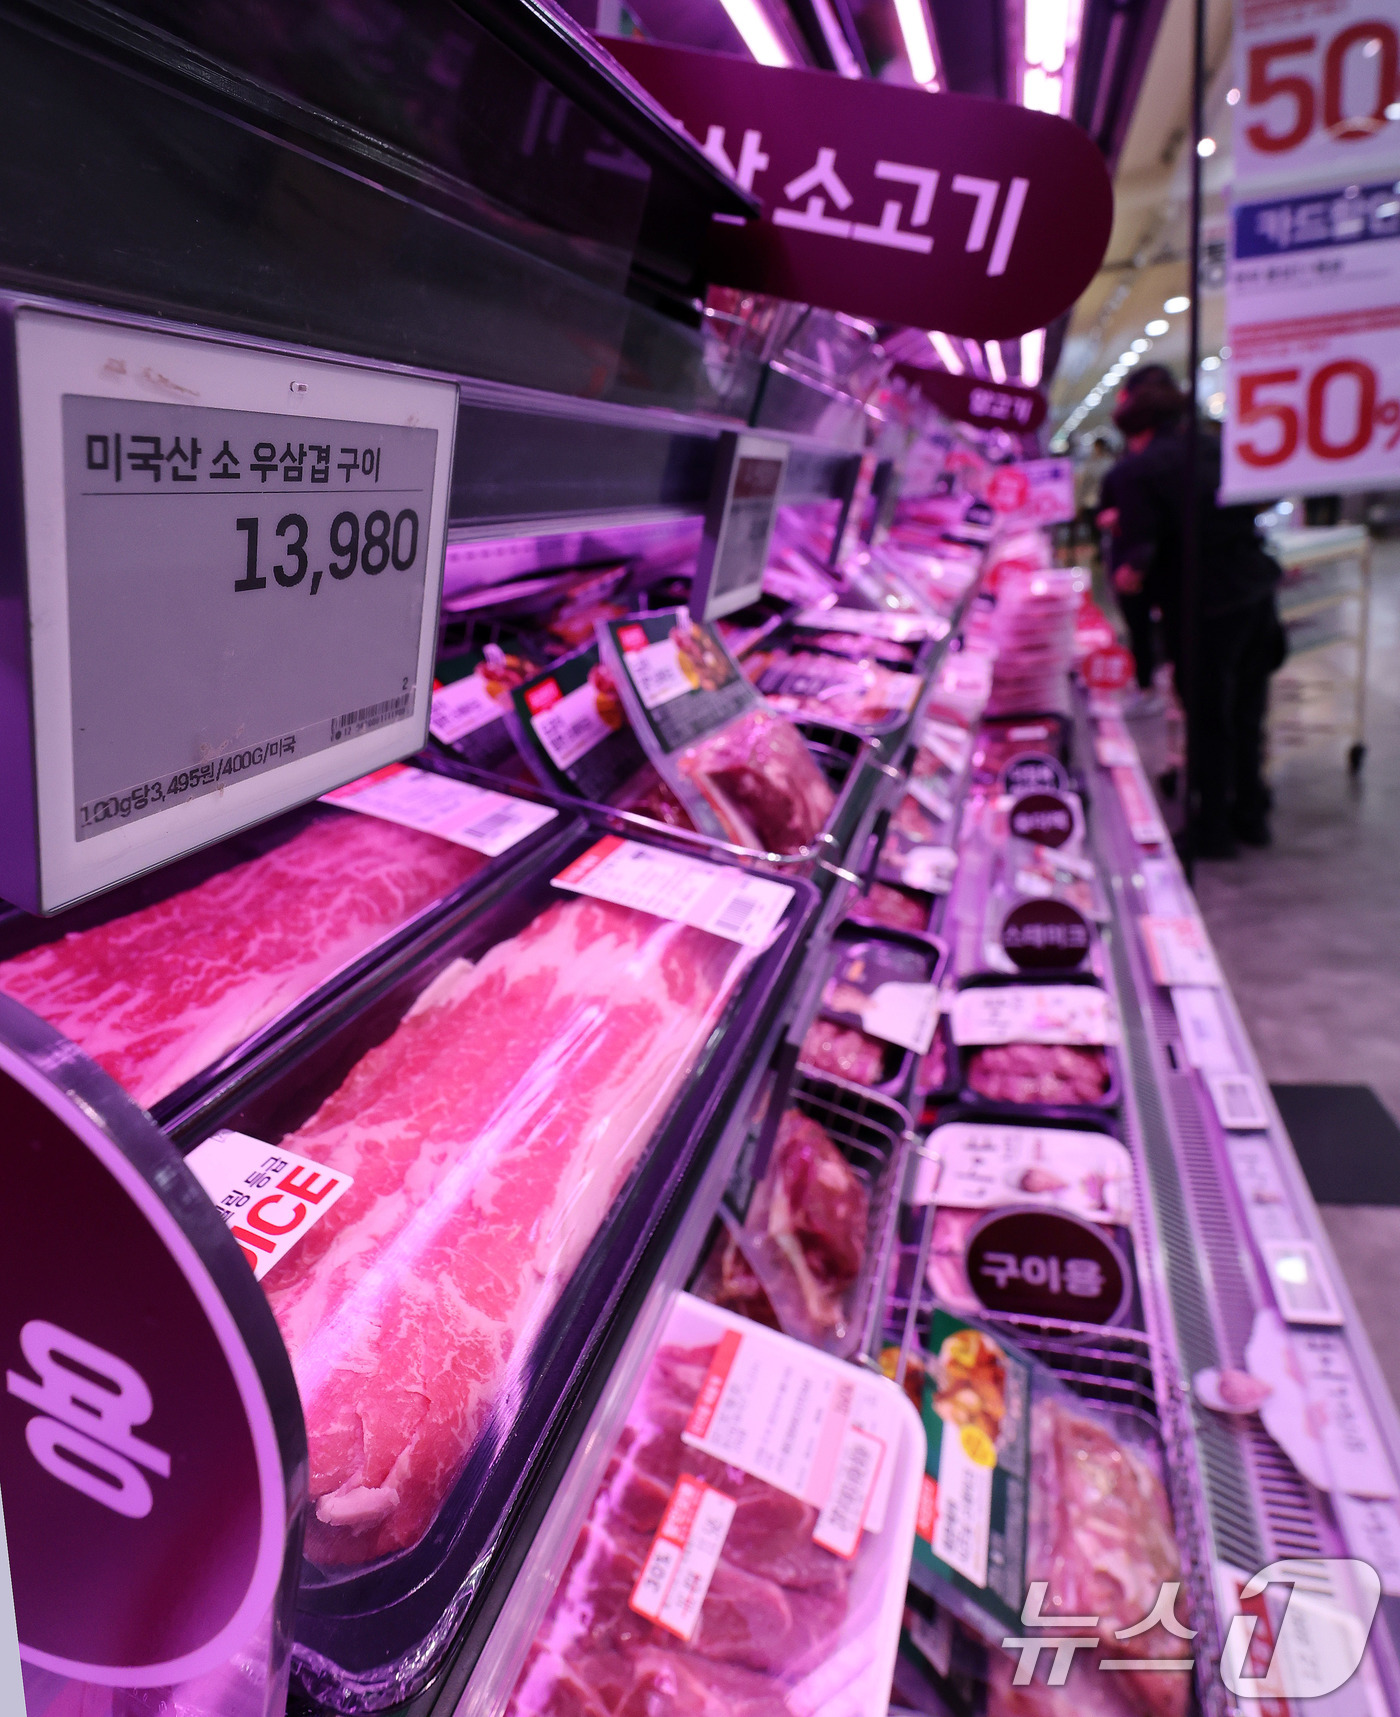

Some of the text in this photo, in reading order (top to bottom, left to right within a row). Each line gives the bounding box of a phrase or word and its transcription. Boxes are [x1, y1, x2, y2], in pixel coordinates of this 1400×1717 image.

[773, 147, 1029, 278] 소고기
[86, 433, 382, 484] 미국산 소 우삼겹 구이
[233, 508, 419, 596] 13,980
[402, 677, 409, 691] 2
[244, 1156, 288, 1188] 등급
[979, 1250, 1107, 1298] 구이용
